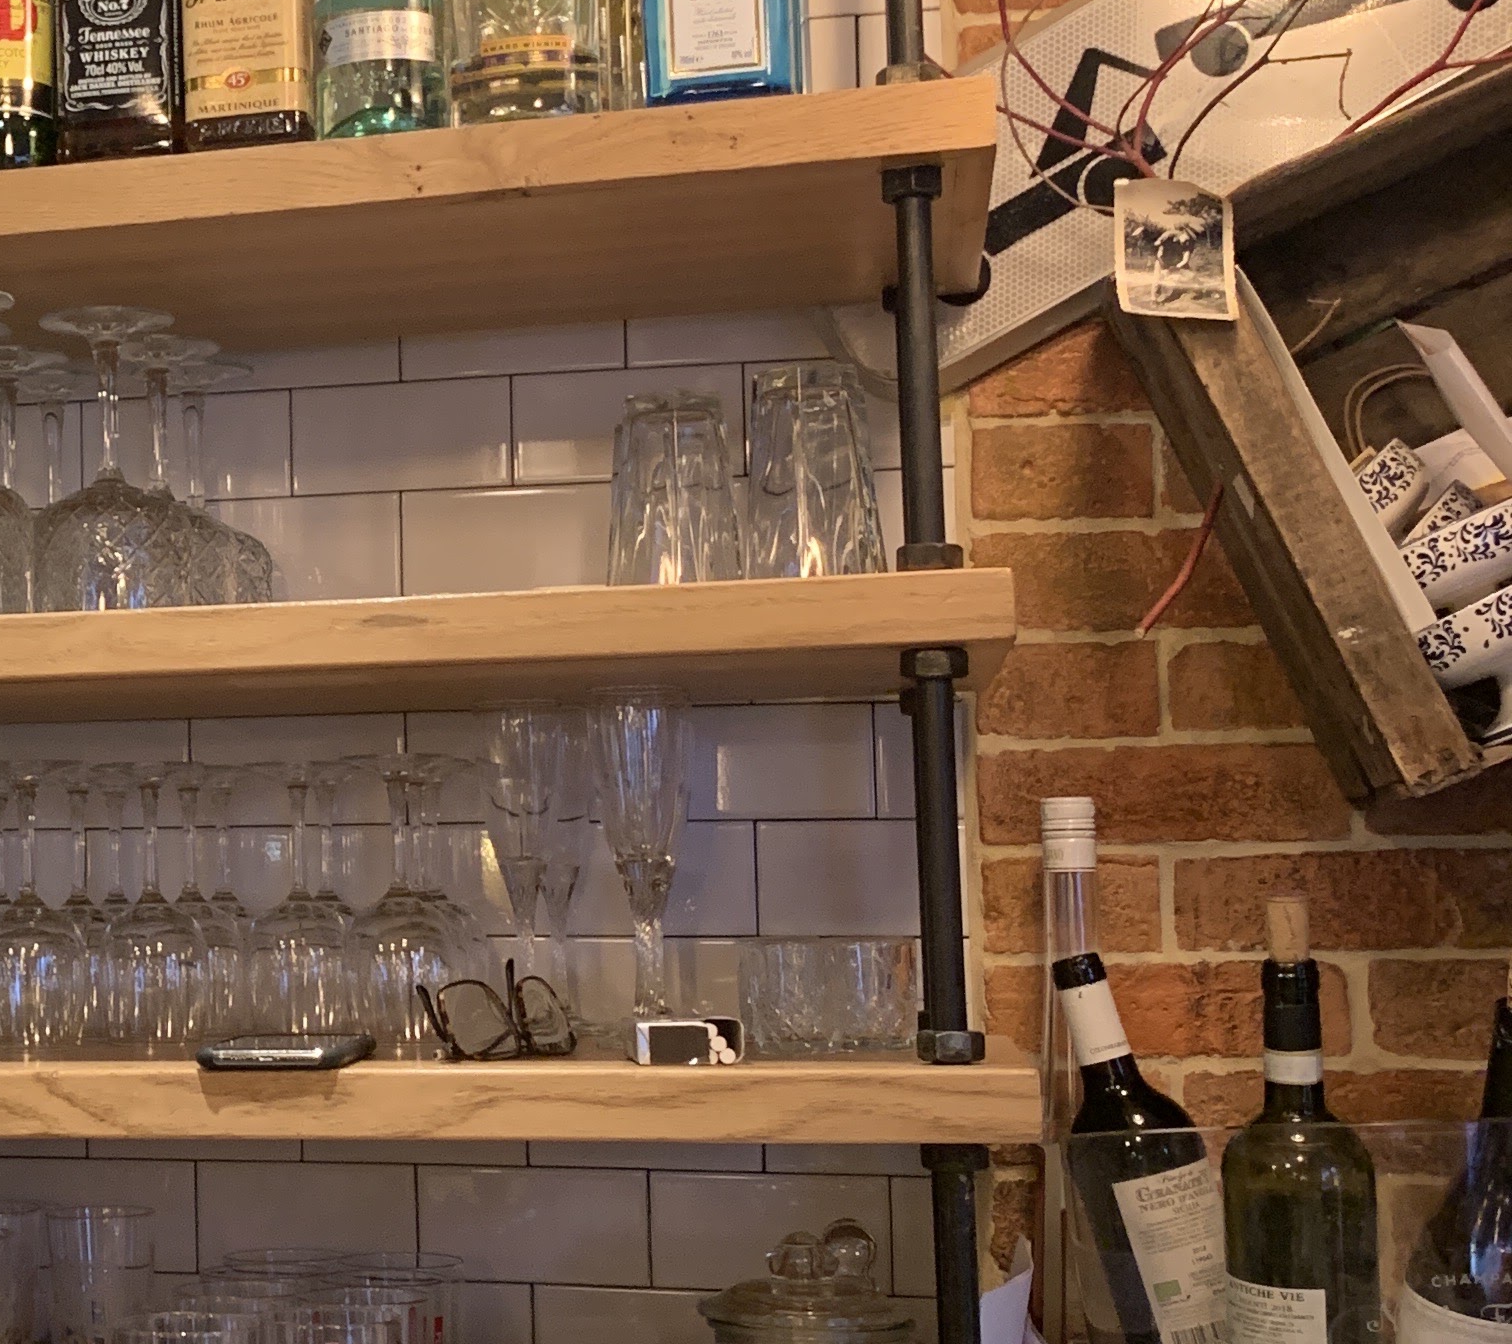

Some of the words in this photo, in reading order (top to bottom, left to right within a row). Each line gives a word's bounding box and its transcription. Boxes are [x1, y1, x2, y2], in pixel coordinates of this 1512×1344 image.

[194, 17, 225, 30] RHUM
[228, 13, 279, 26] AGRICOLE
[77, 25, 151, 44] Tennessee
[79, 46, 150, 63] WHISKEY
[85, 63, 106, 77] 70cl
[106, 61, 127, 74] 40%
[197, 97, 280, 115] MARTINIQUE
